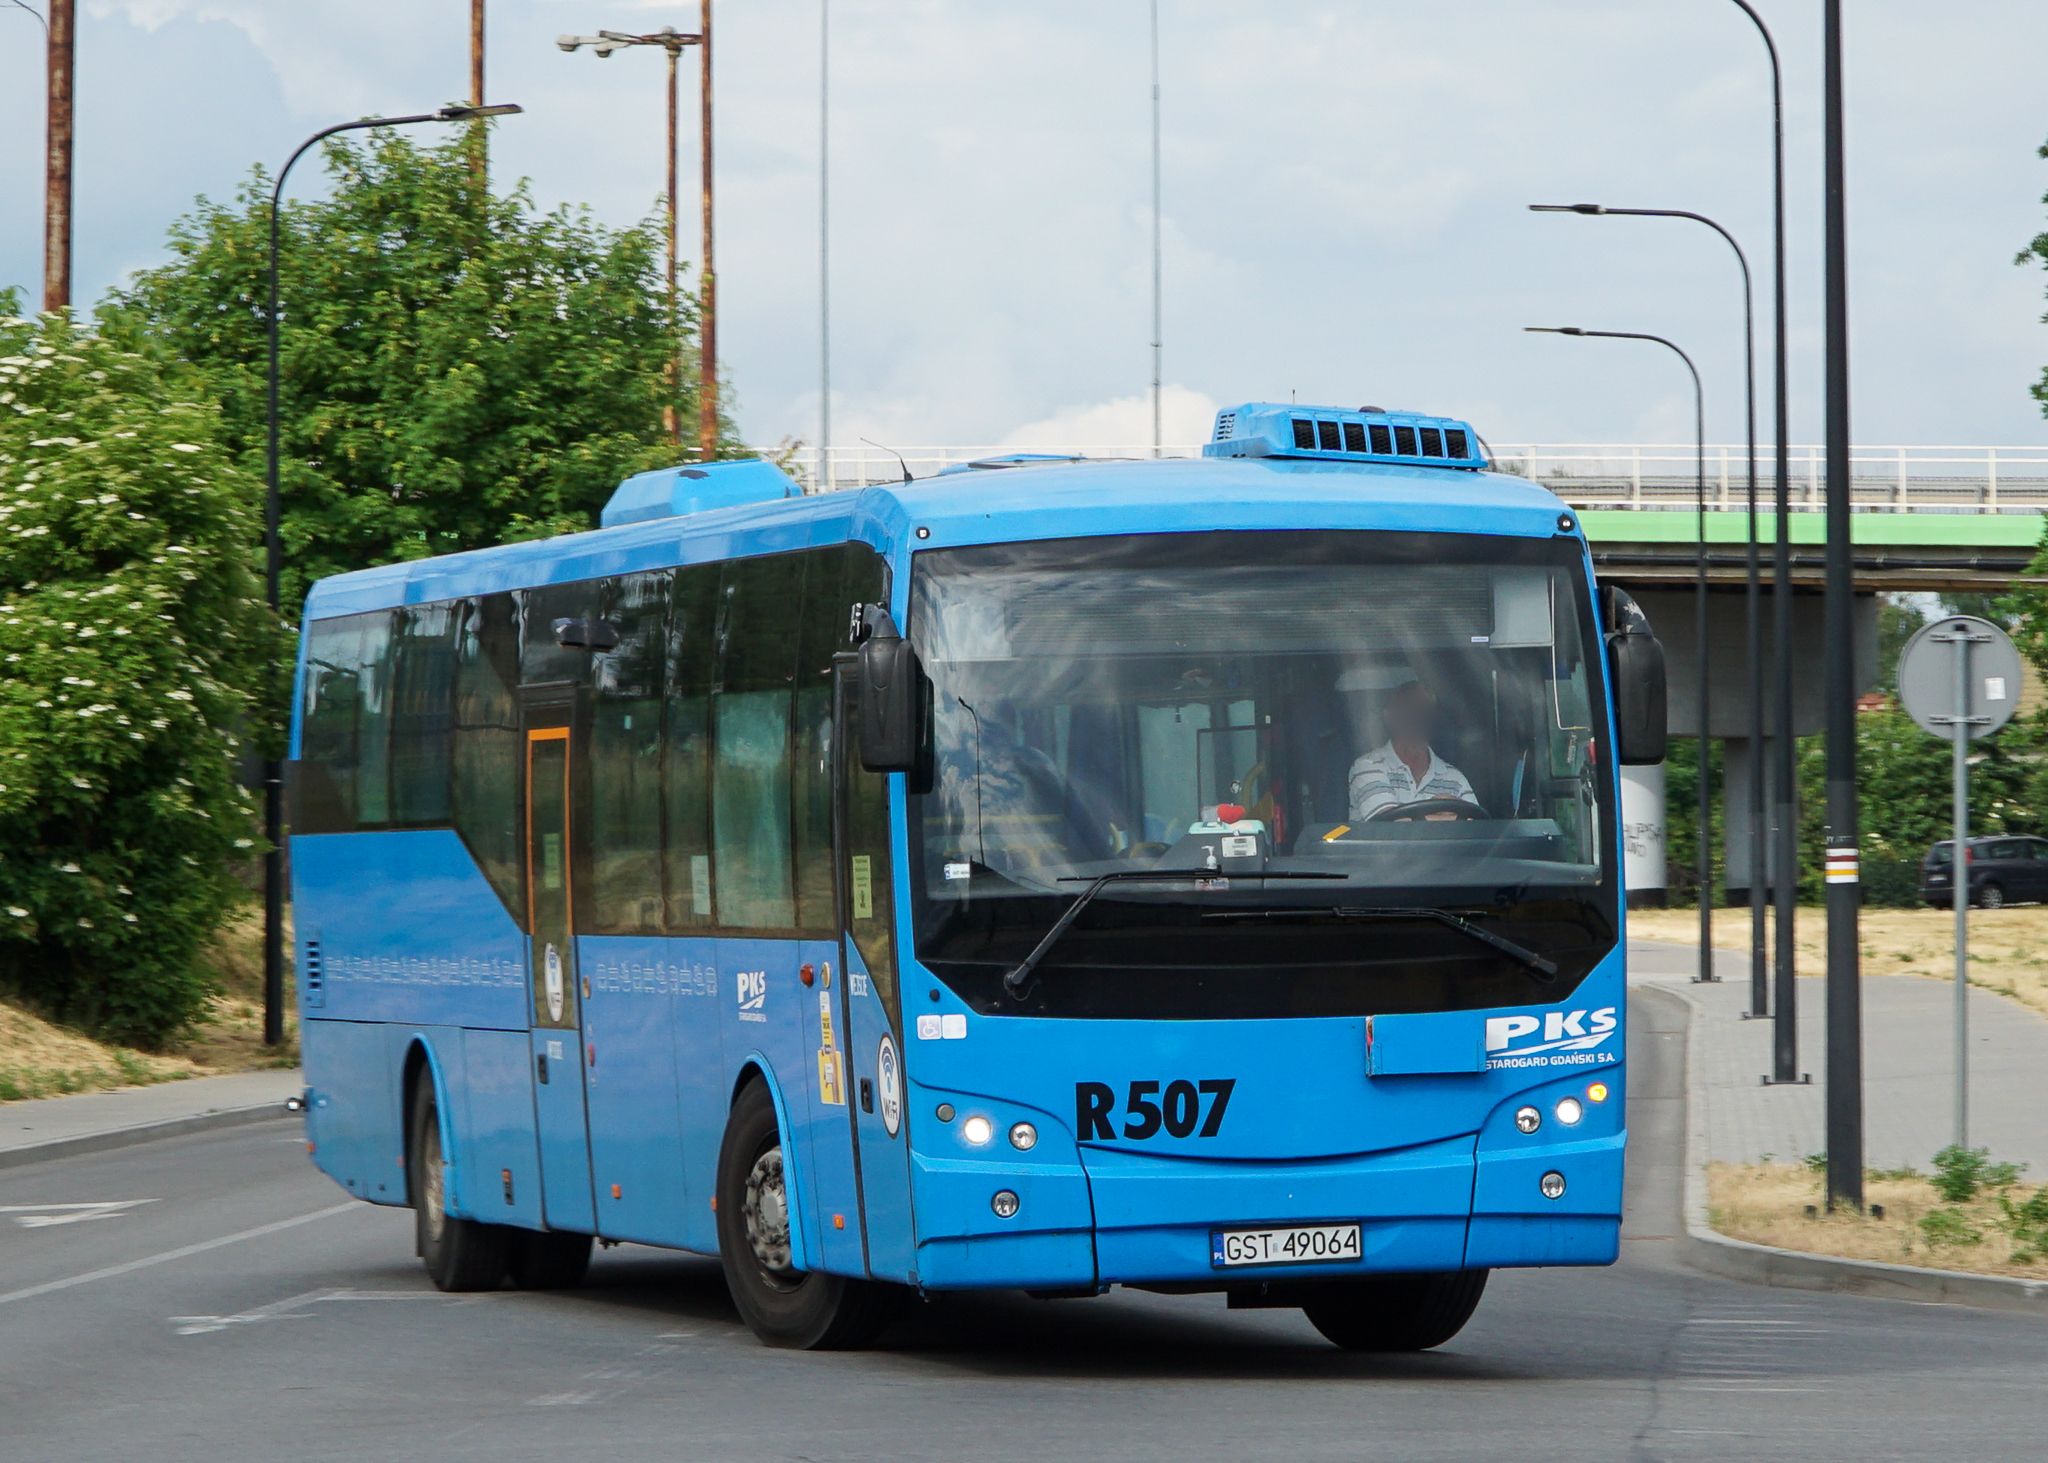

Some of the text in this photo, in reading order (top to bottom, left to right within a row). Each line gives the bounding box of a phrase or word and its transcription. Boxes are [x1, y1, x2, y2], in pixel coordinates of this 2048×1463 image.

[737, 971, 765, 1003] PKS
[1486, 1007, 1617, 1051] PKS
[1486, 1055, 1548, 1070] STAROGARD
[1550, 1051, 1595, 1065] GDAŃSKI
[1213, 1252, 1224, 1260] PL
[1226, 1228, 1357, 1260] GST 49064
